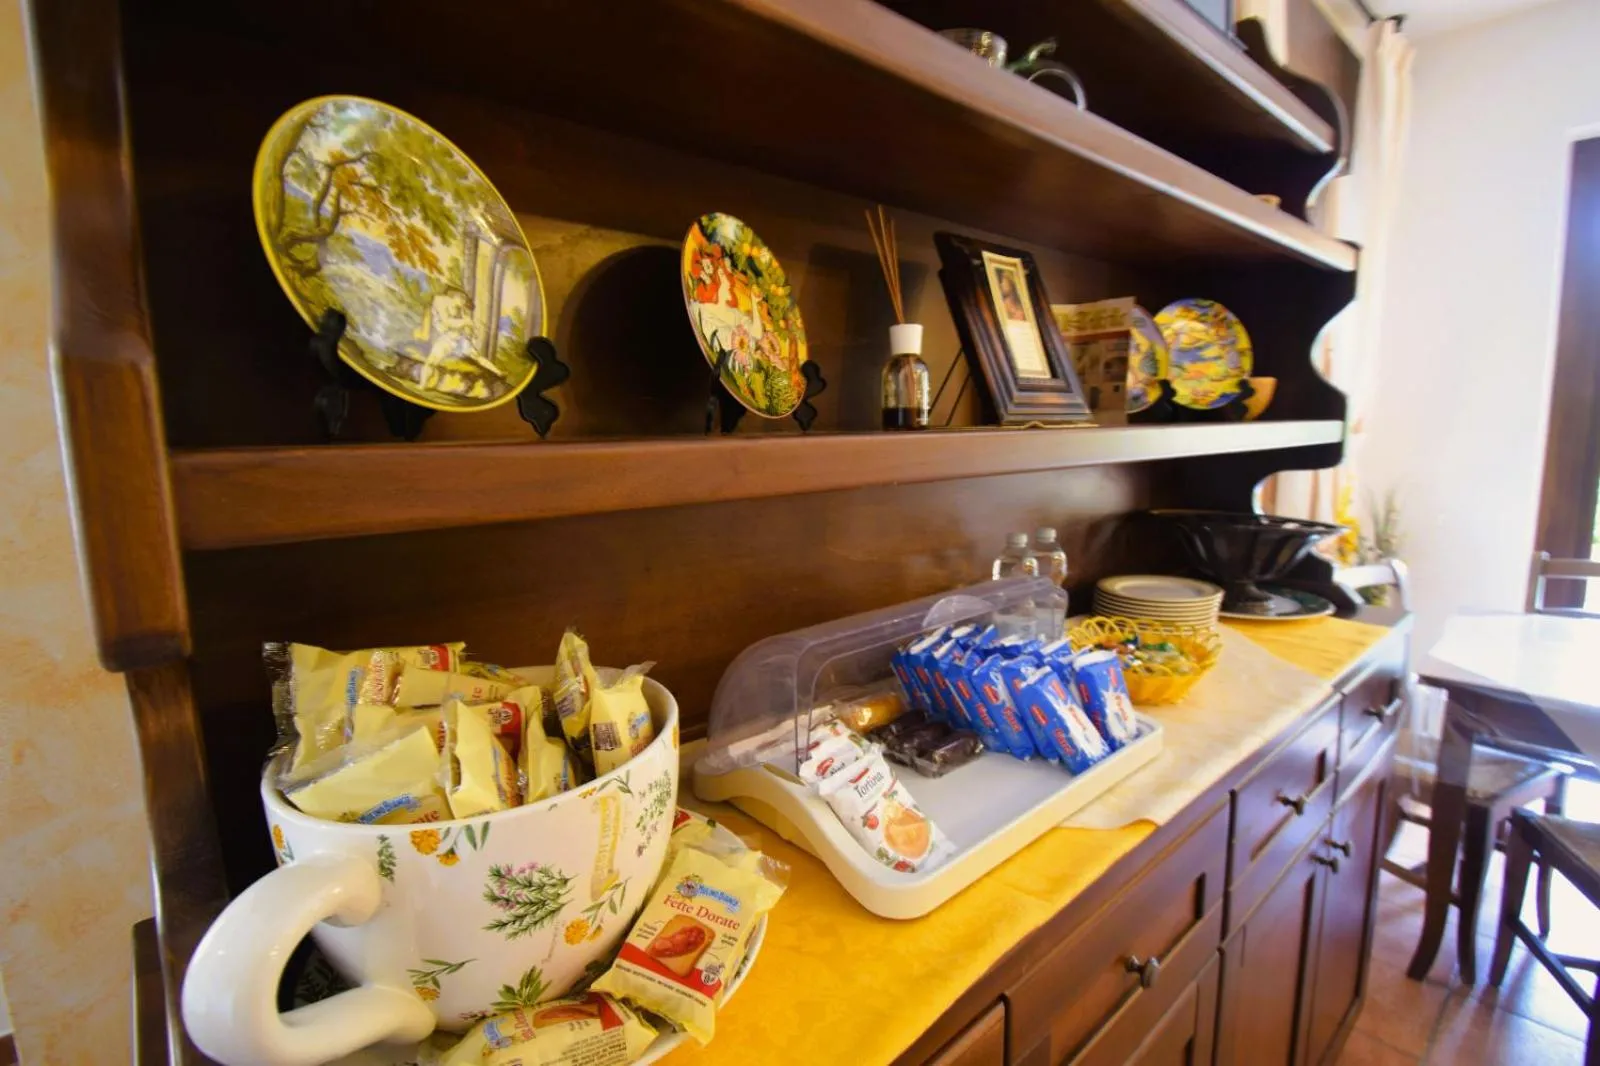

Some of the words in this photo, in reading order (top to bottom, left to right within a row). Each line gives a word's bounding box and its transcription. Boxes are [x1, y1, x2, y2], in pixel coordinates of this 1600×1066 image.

[854, 771, 884, 798] Tortina
[663, 894, 694, 914] Fette
[696, 905, 741, 930] Dorate
